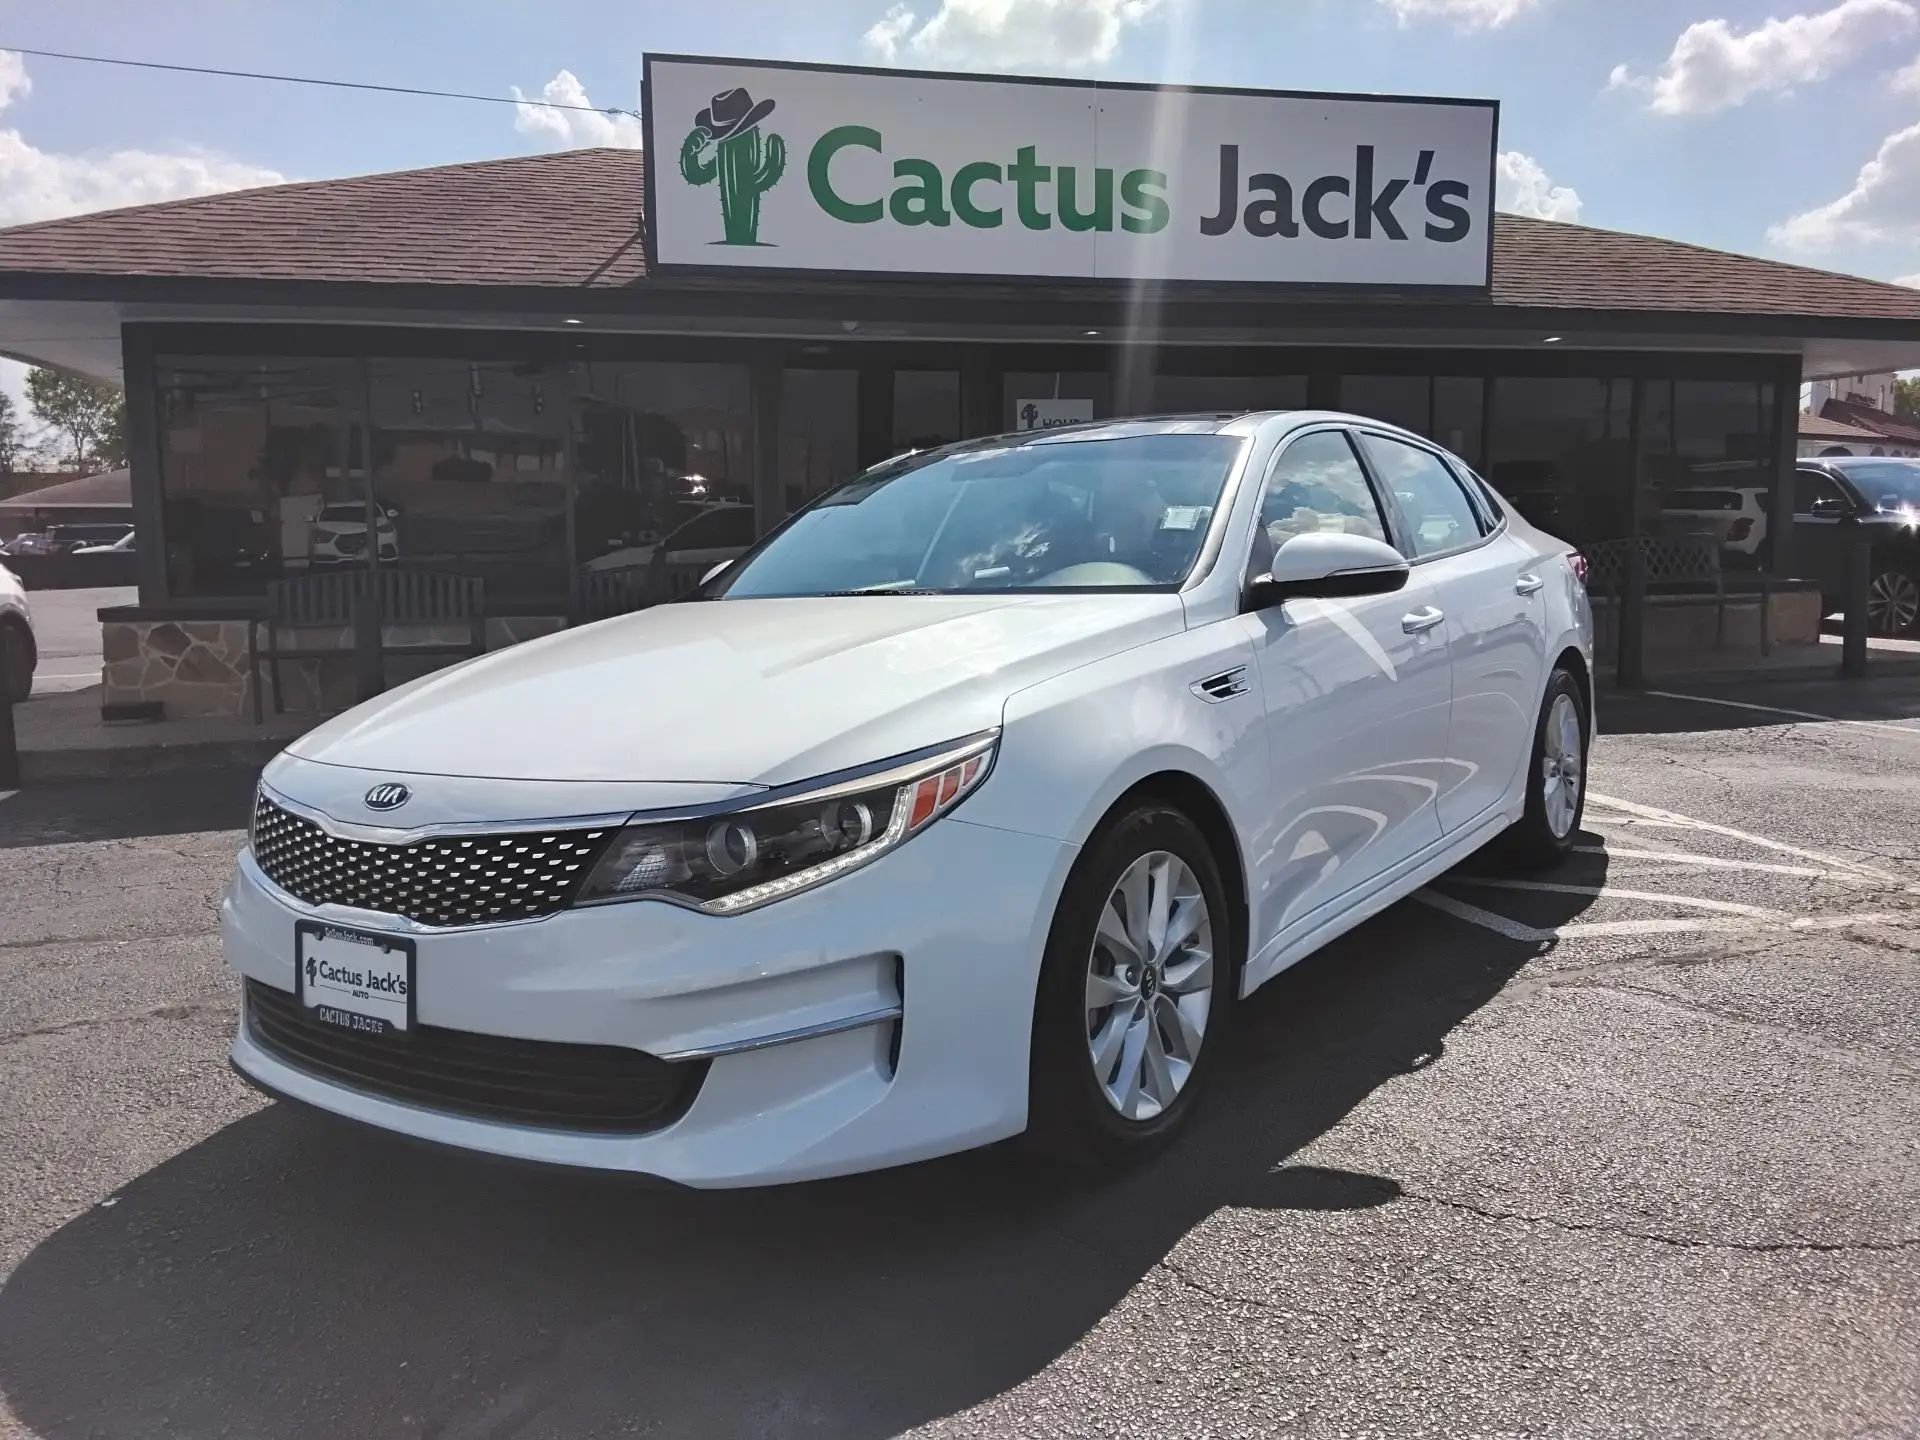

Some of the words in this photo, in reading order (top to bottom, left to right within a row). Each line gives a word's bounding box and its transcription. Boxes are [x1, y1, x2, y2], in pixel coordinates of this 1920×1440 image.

[807, 125, 1170, 235] Cactus
[1199, 144, 1472, 244] Jack's
[367, 785, 403, 804] KIA
[319, 960, 363, 987] Cactus
[366, 969, 408, 995] Jack's
[352, 989, 369, 1000] AUTO
[320, 1007, 350, 1027] CACTUS
